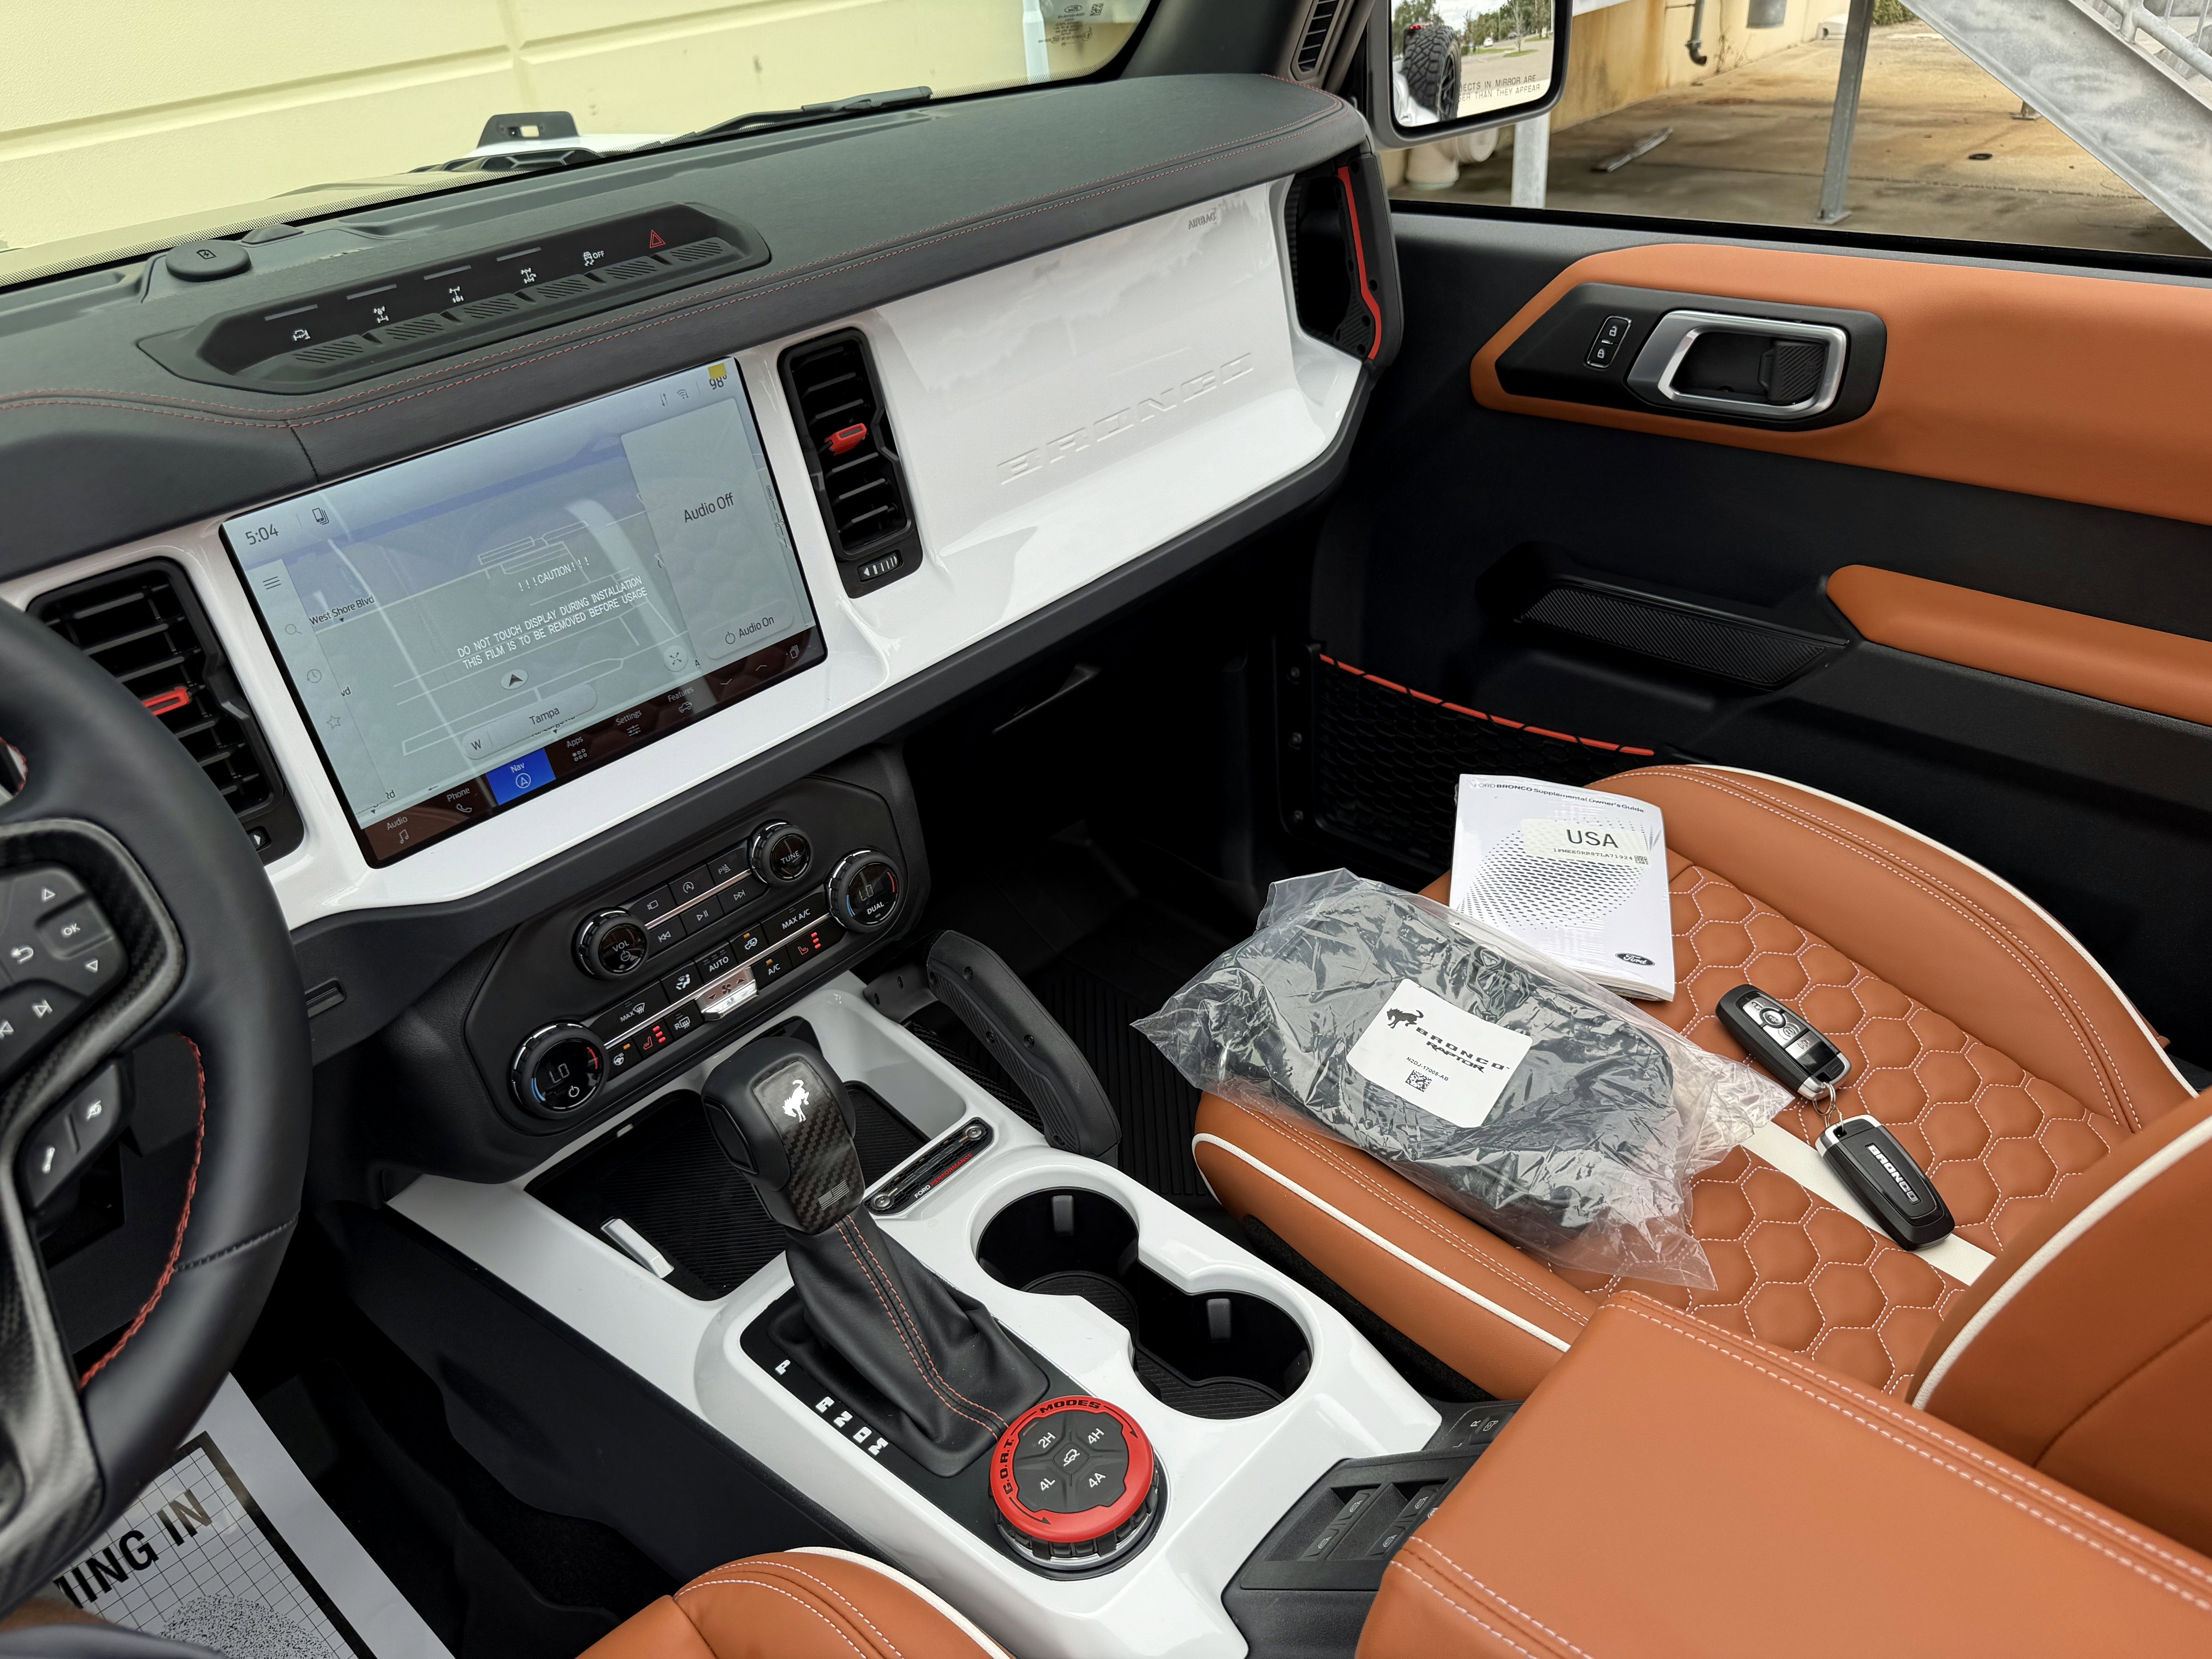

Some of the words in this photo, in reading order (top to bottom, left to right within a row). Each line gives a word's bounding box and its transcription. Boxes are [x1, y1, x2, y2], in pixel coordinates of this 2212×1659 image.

[1459, 82, 1481, 92] JECTS
[1484, 81, 1491, 89] IN
[1495, 76, 1520, 86] MIRROR
[1458, 94, 1471, 102] SER
[1475, 90, 1492, 100] THAN
[1496, 88, 1512, 97] THEY
[1515, 84, 1540, 94] APPEAR
[1188, 211, 1216, 230] AIRBAG
[593, 251, 605, 259] OFF
[997, 353, 1254, 485] BRONCO
[684, 501, 716, 523] Audio
[717, 492, 734, 510] Off
[245, 524, 279, 545] 5:04
[309, 611, 332, 626] West
[332, 602, 356, 618] Shore
[356, 594, 374, 610] Blvd
[457, 646, 471, 658] DO
[473, 636, 491, 651] NOT
[494, 624, 522, 641] TOUCH
[525, 610, 557, 630] DISPLAY
[560, 597, 590, 616] DURING
[591, 576, 643, 603] INSTALLATION
[463, 655, 483, 669] THIS
[486, 646, 505, 660] FILM
[507, 641, 517, 651] IS
[519, 635, 531, 646] TO
[534, 629, 546, 641] BE
[549, 612, 587, 634] REMOVED
[589, 600, 620, 618] BEFORE
[622, 587, 648, 605] USAGE
[739, 621, 762, 639] Audio
[762, 616, 775, 627] On
[667, 686, 694, 703] Features
[529, 708, 560, 725] Tampa
[616, 709, 642, 726] Settings
[471, 739, 482, 750] W
[566, 736, 584, 749] Apps
[510, 761, 525, 774] Nav
[447, 787, 471, 802] Phone
[1496, 783, 1532, 792] BRONCO
[1533, 788, 1588, 802] Supplemental
[1589, 797, 1621, 808] Owner's
[1621, 803, 1644, 813] Guide
[386, 815, 408, 831] Audio
[1566, 829, 1619, 848] USA
[780, 850, 800, 864] TUNE
[859, 884, 874, 902] LO
[867, 902, 884, 915] DUAL
[782, 916, 798, 930] MAX
[799, 908, 811, 920] A/C
[61, 923, 81, 938] OK
[612, 940, 630, 953] VOL
[709, 956, 730, 972] AUTO
[768, 963, 781, 975] A/C
[620, 1010, 635, 1022] MAX
[1416, 1027, 1505, 1070] BRONCO
[1425, 1041, 1485, 1073] RAPTOR
[548, 1063, 570, 1084] LO
[1406, 1057, 1449, 1081] N2DJ-17005-AB
[914, 1185, 931, 1198] FORD
[930, 1153, 973, 1186] PERFORMANCE
[1868, 1144, 1920, 1204] BRONCO
[775, 1359, 791, 1375] P
[1039, 1400, 1101, 1414] MODES
[1038, 1432, 1056, 1448] 2H
[1087, 1428, 1104, 1444] 4H
[1040, 1477, 1056, 1491] 4L
[1089, 1473, 1106, 1488] 4A
[156, 1489, 213, 1547] IN
